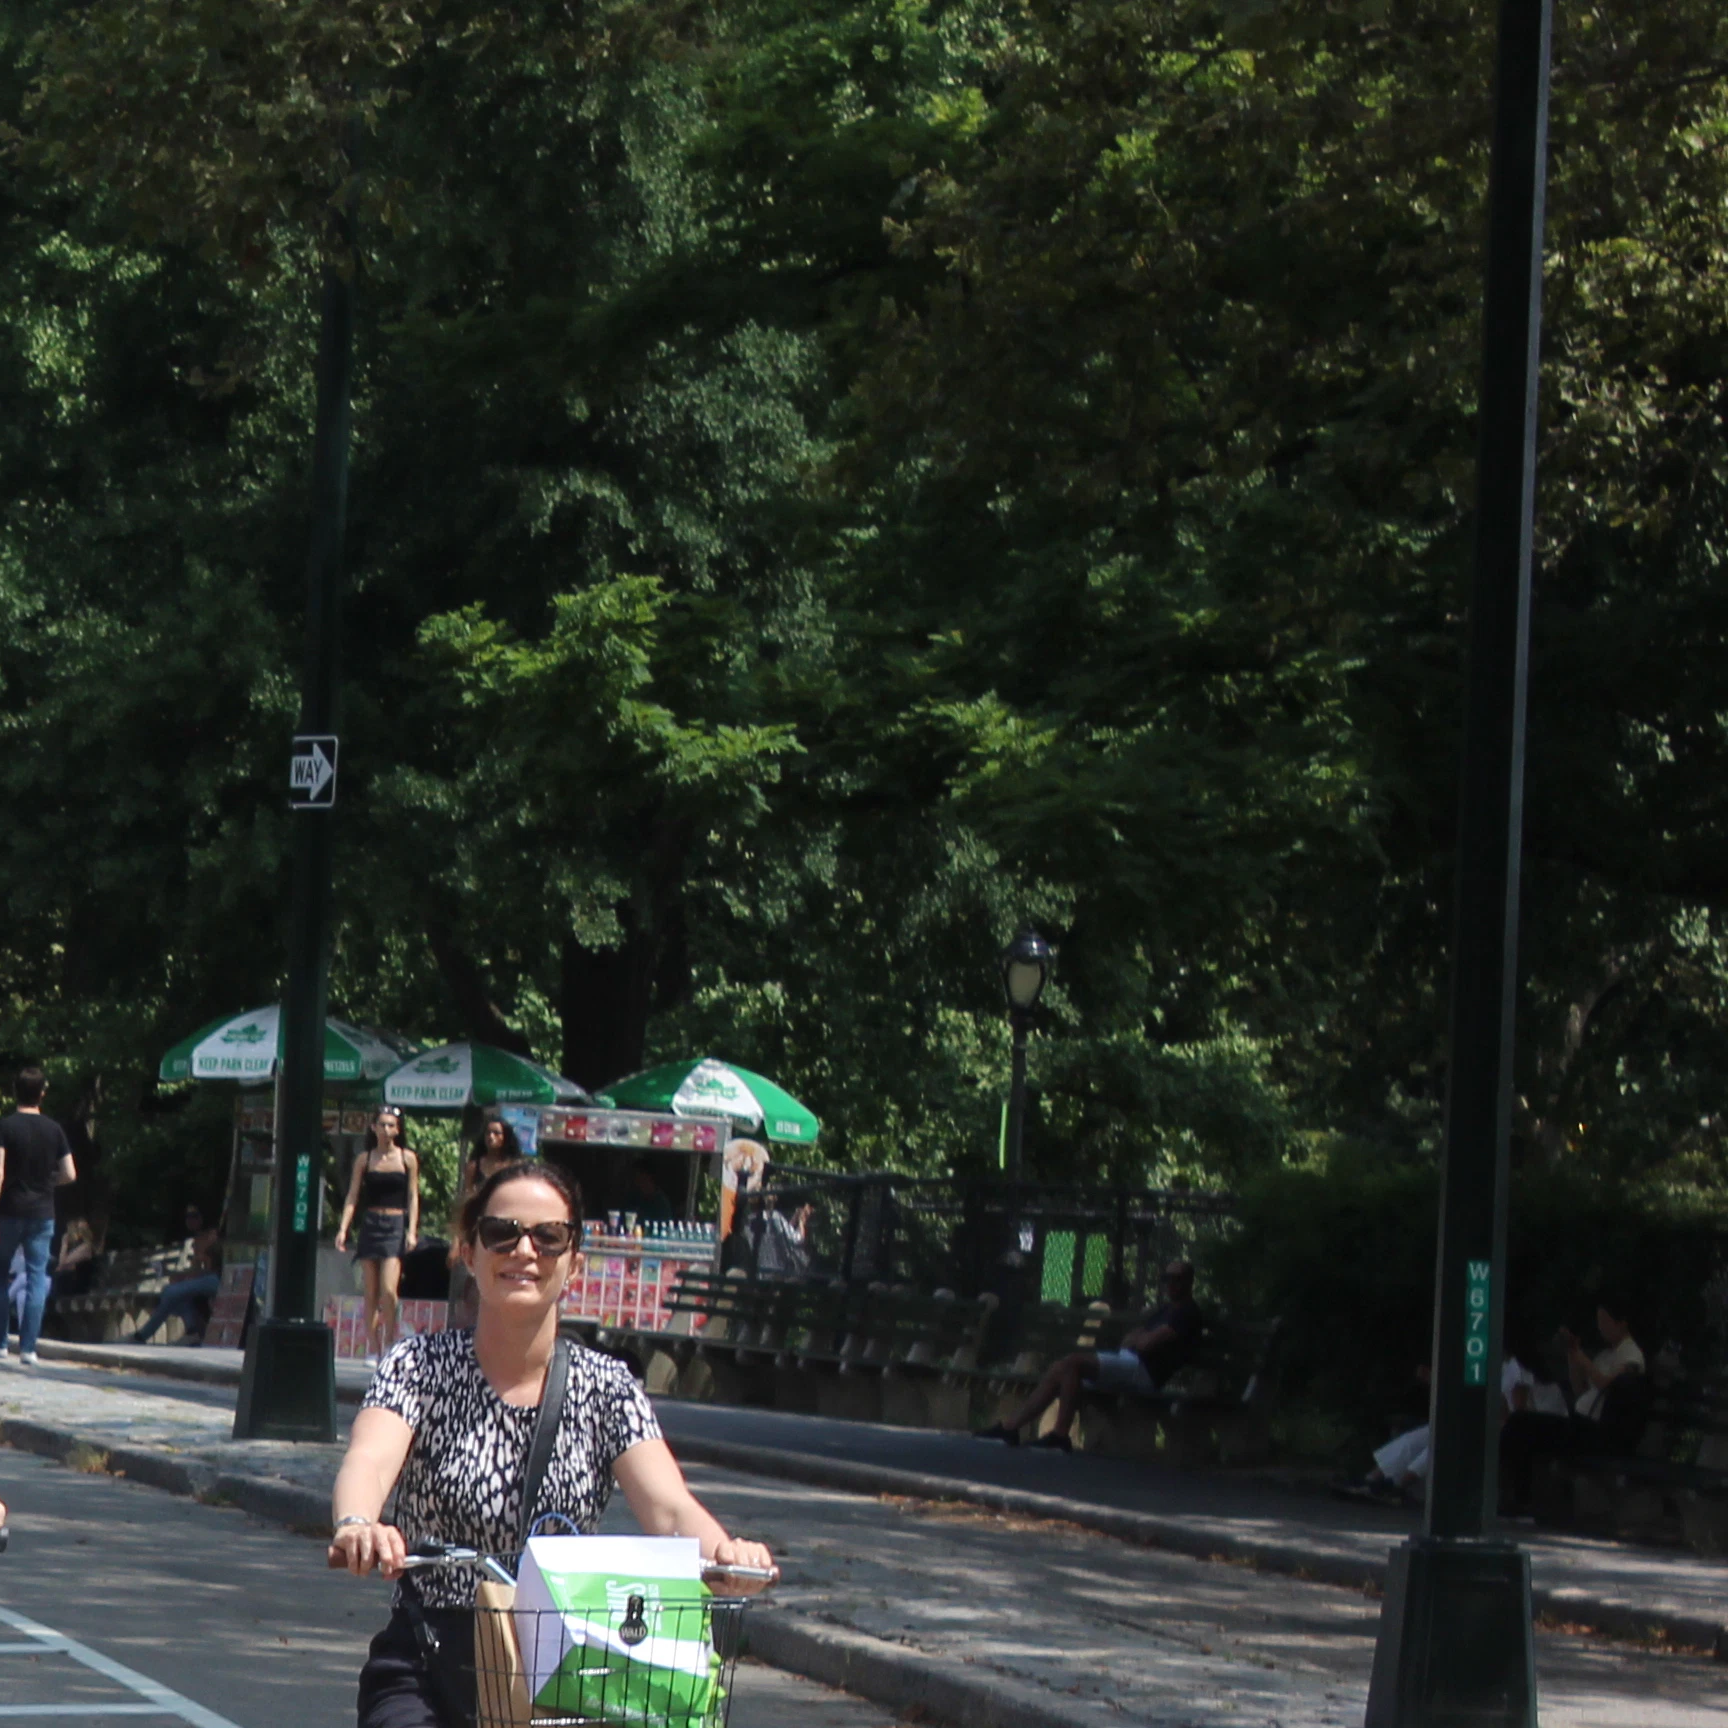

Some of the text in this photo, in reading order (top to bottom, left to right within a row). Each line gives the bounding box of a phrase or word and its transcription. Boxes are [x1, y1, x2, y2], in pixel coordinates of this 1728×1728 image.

[295, 758, 324, 785] WAY
[220, 1057, 242, 1071] PARK
[414, 1086, 437, 1099] PARK
[295, 1153, 310, 1233] W6702
[1466, 1262, 1490, 1382] W6701
[621, 1626, 646, 1639] WALD
